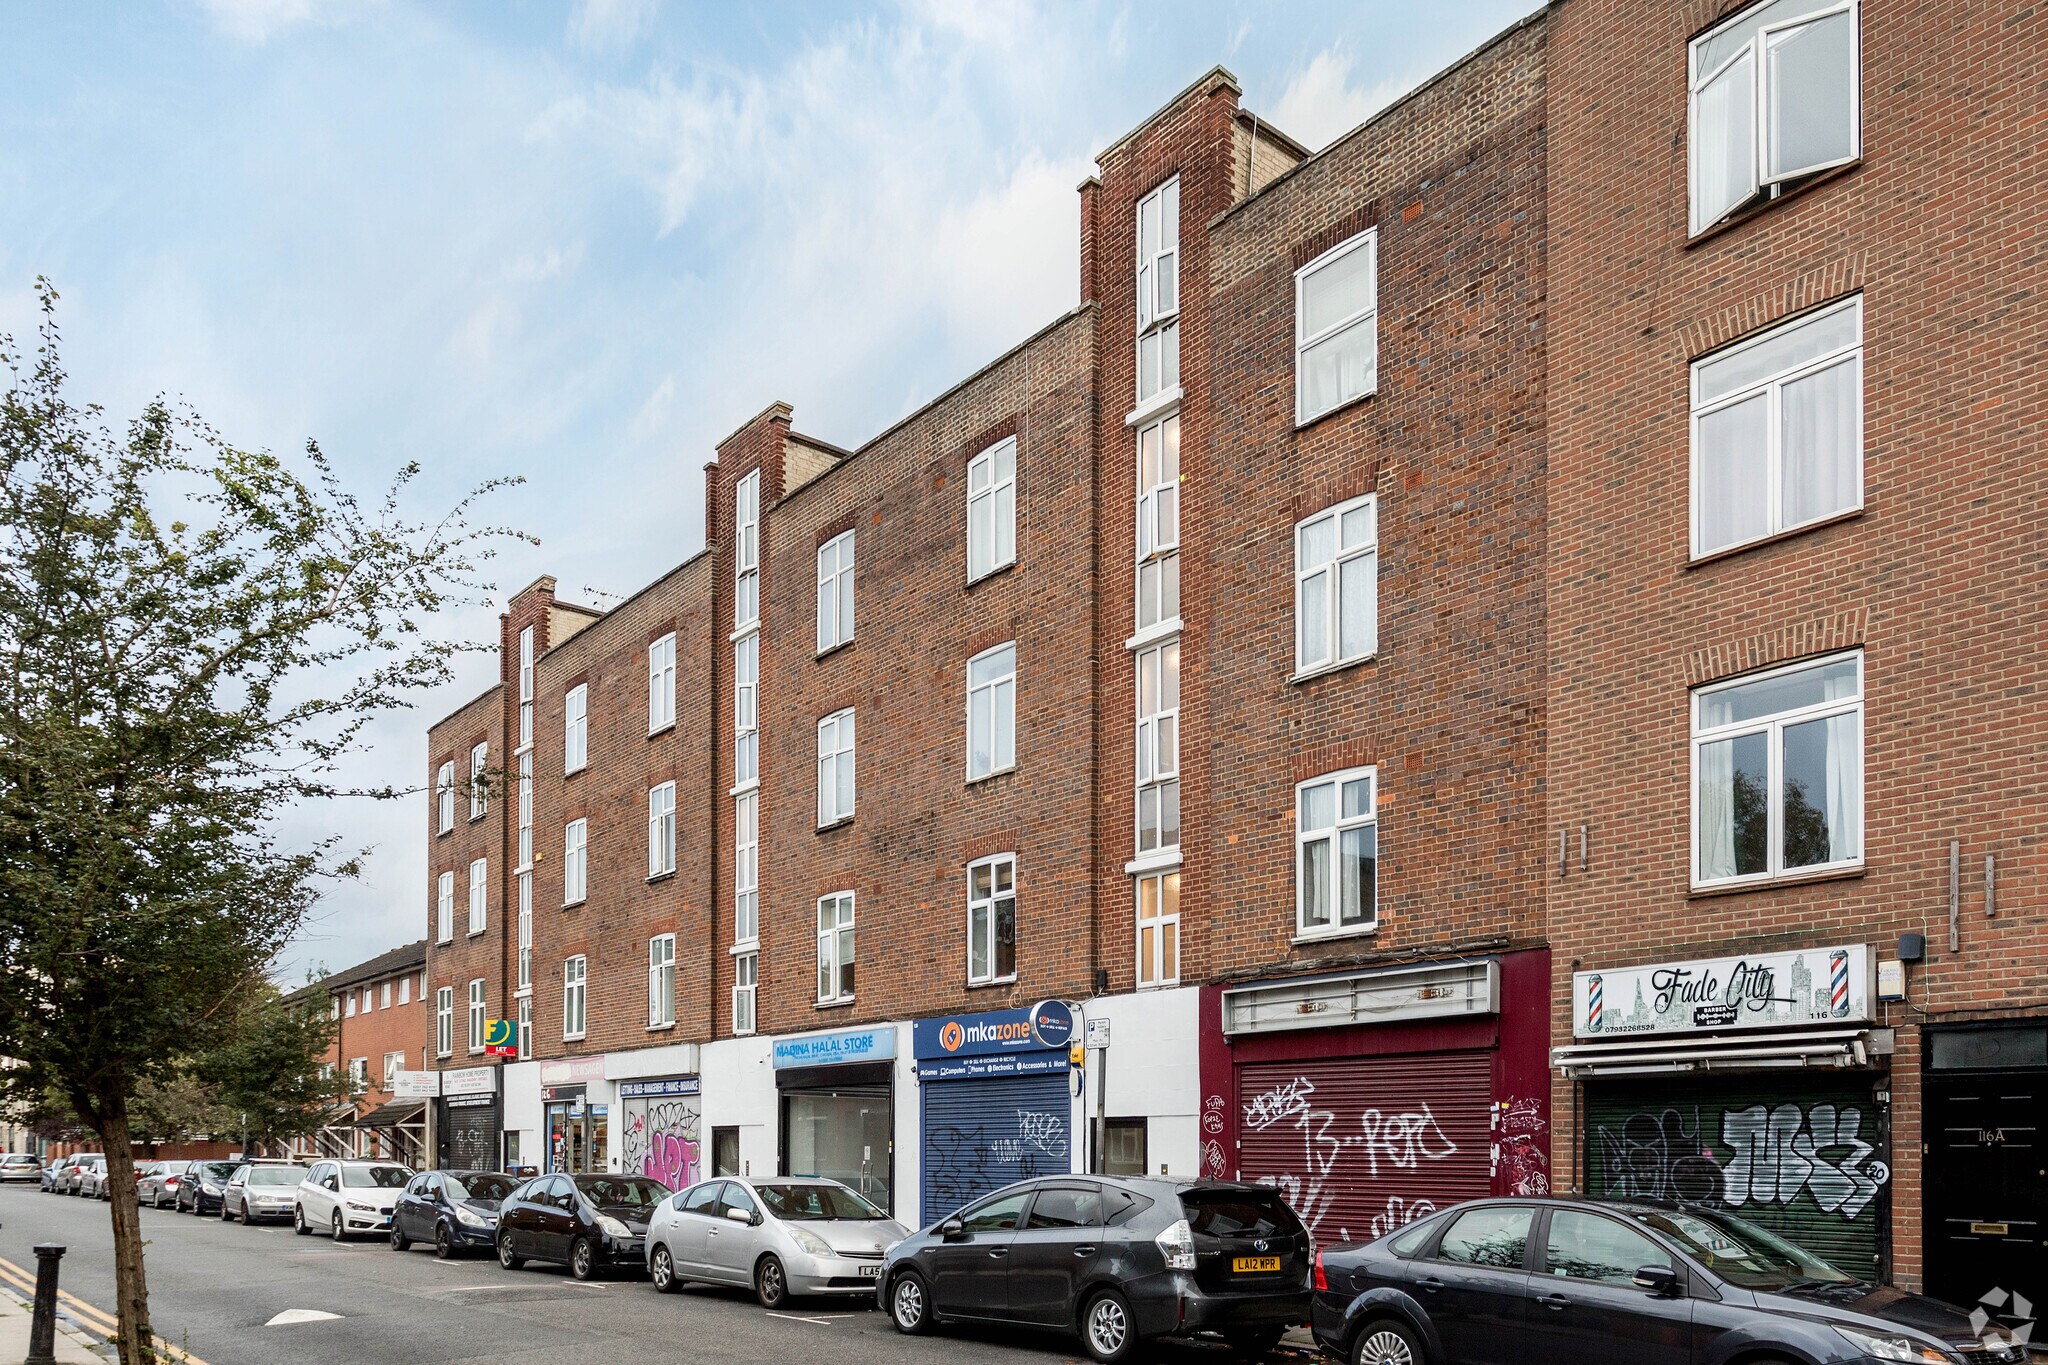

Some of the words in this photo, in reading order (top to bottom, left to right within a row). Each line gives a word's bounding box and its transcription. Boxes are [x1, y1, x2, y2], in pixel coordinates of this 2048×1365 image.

[1652, 968, 1718, 1014] Fade
[1726, 961, 1797, 1012] City
[1810, 1011, 1828, 1019] 116
[967, 1021, 1031, 1043] mkazone
[812, 1040, 841, 1053] HALAL
[844, 1035, 873, 1049] STORE
[945, 1067, 966, 1075] Computers
[1022, 1061, 1047, 1069] Accessories
[1979, 1130, 2006, 1141] 116A
[1238, 1259, 1258, 1270] LA12
[1260, 1258, 1276, 1269] WPR
